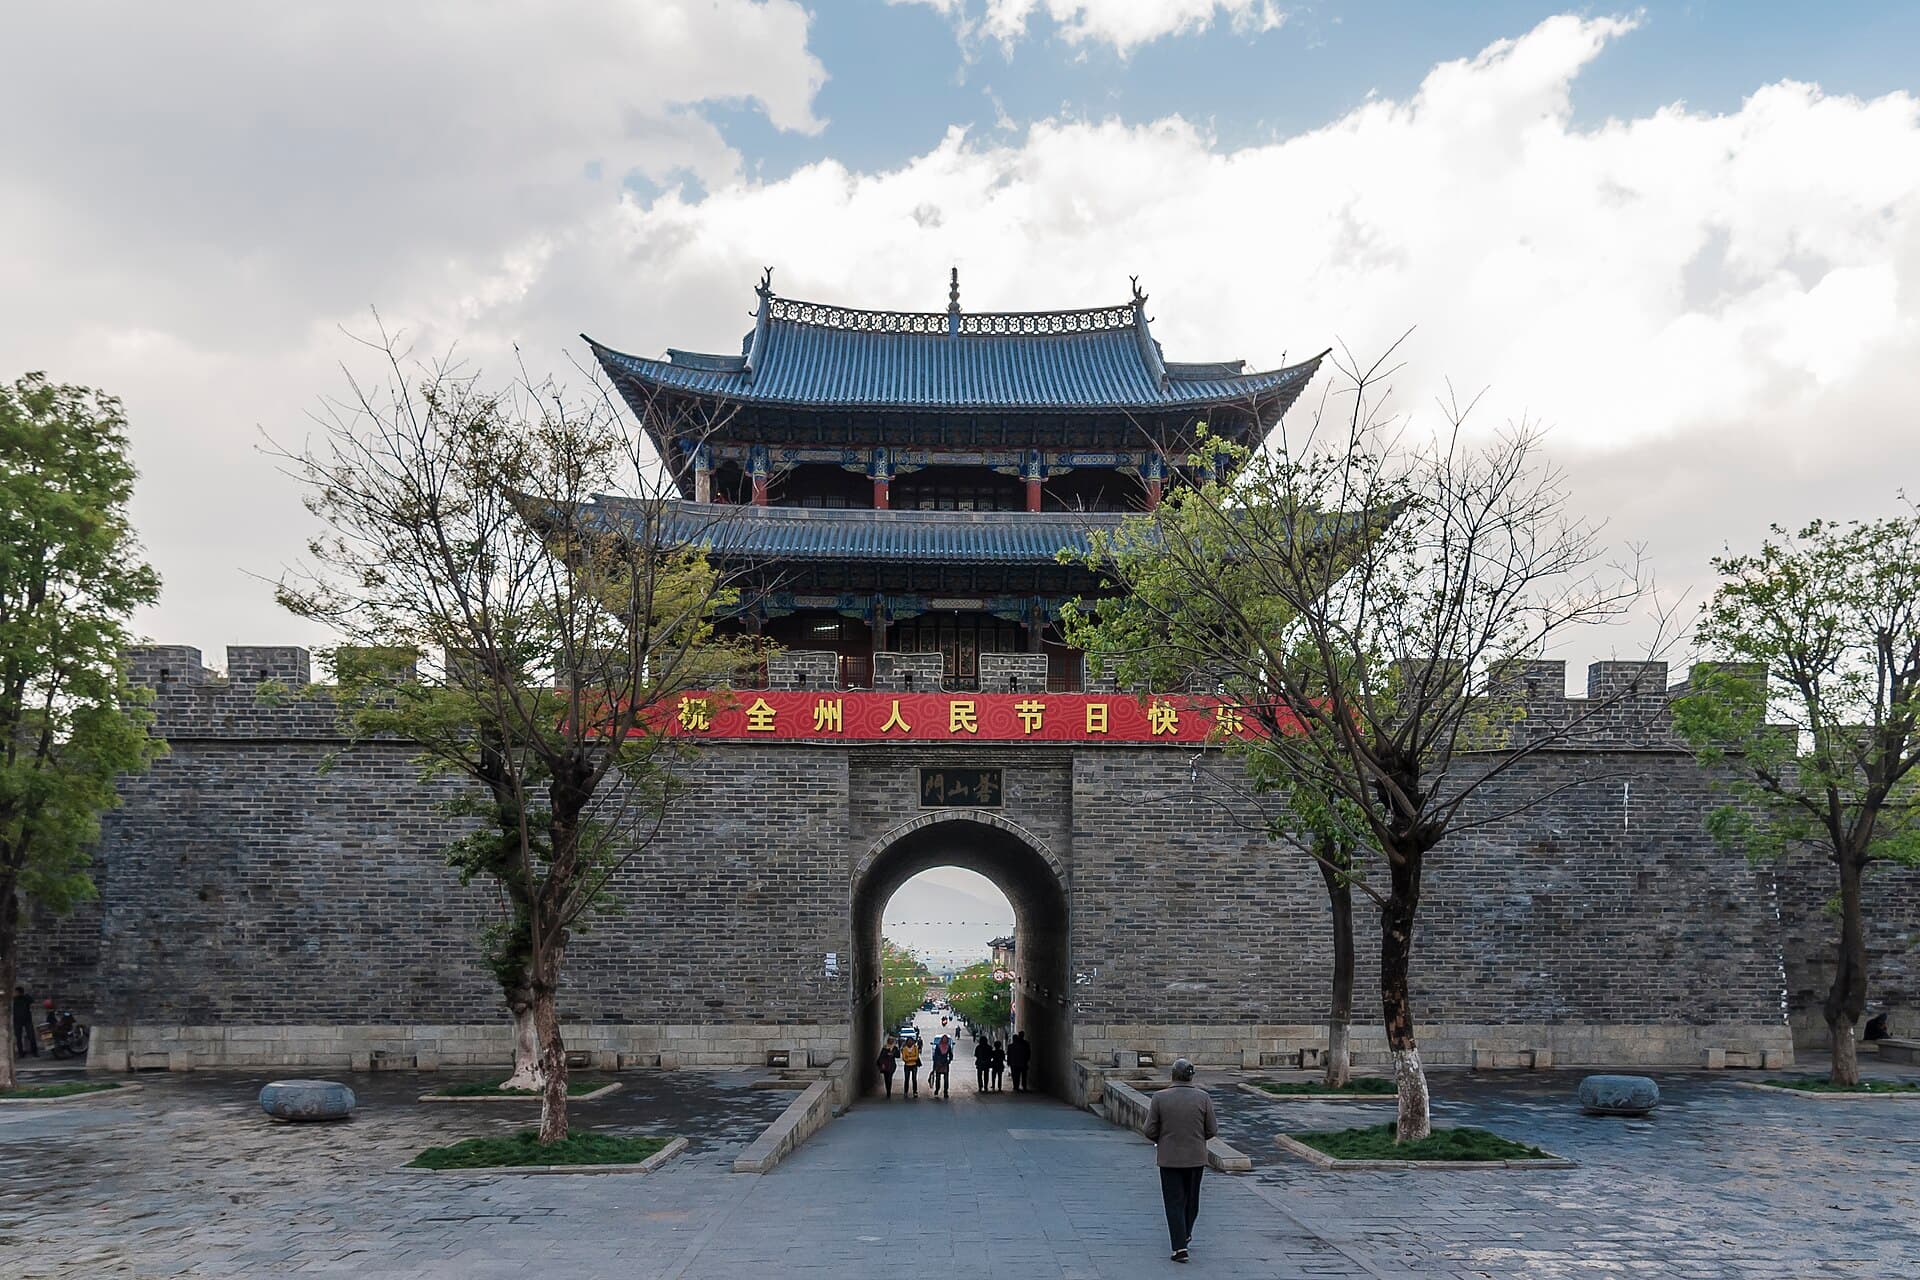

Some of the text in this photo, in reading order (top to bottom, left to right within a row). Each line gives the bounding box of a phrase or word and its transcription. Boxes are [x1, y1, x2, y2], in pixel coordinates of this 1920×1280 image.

[677, 696, 1244, 736] 祝全州人民节日快乐
